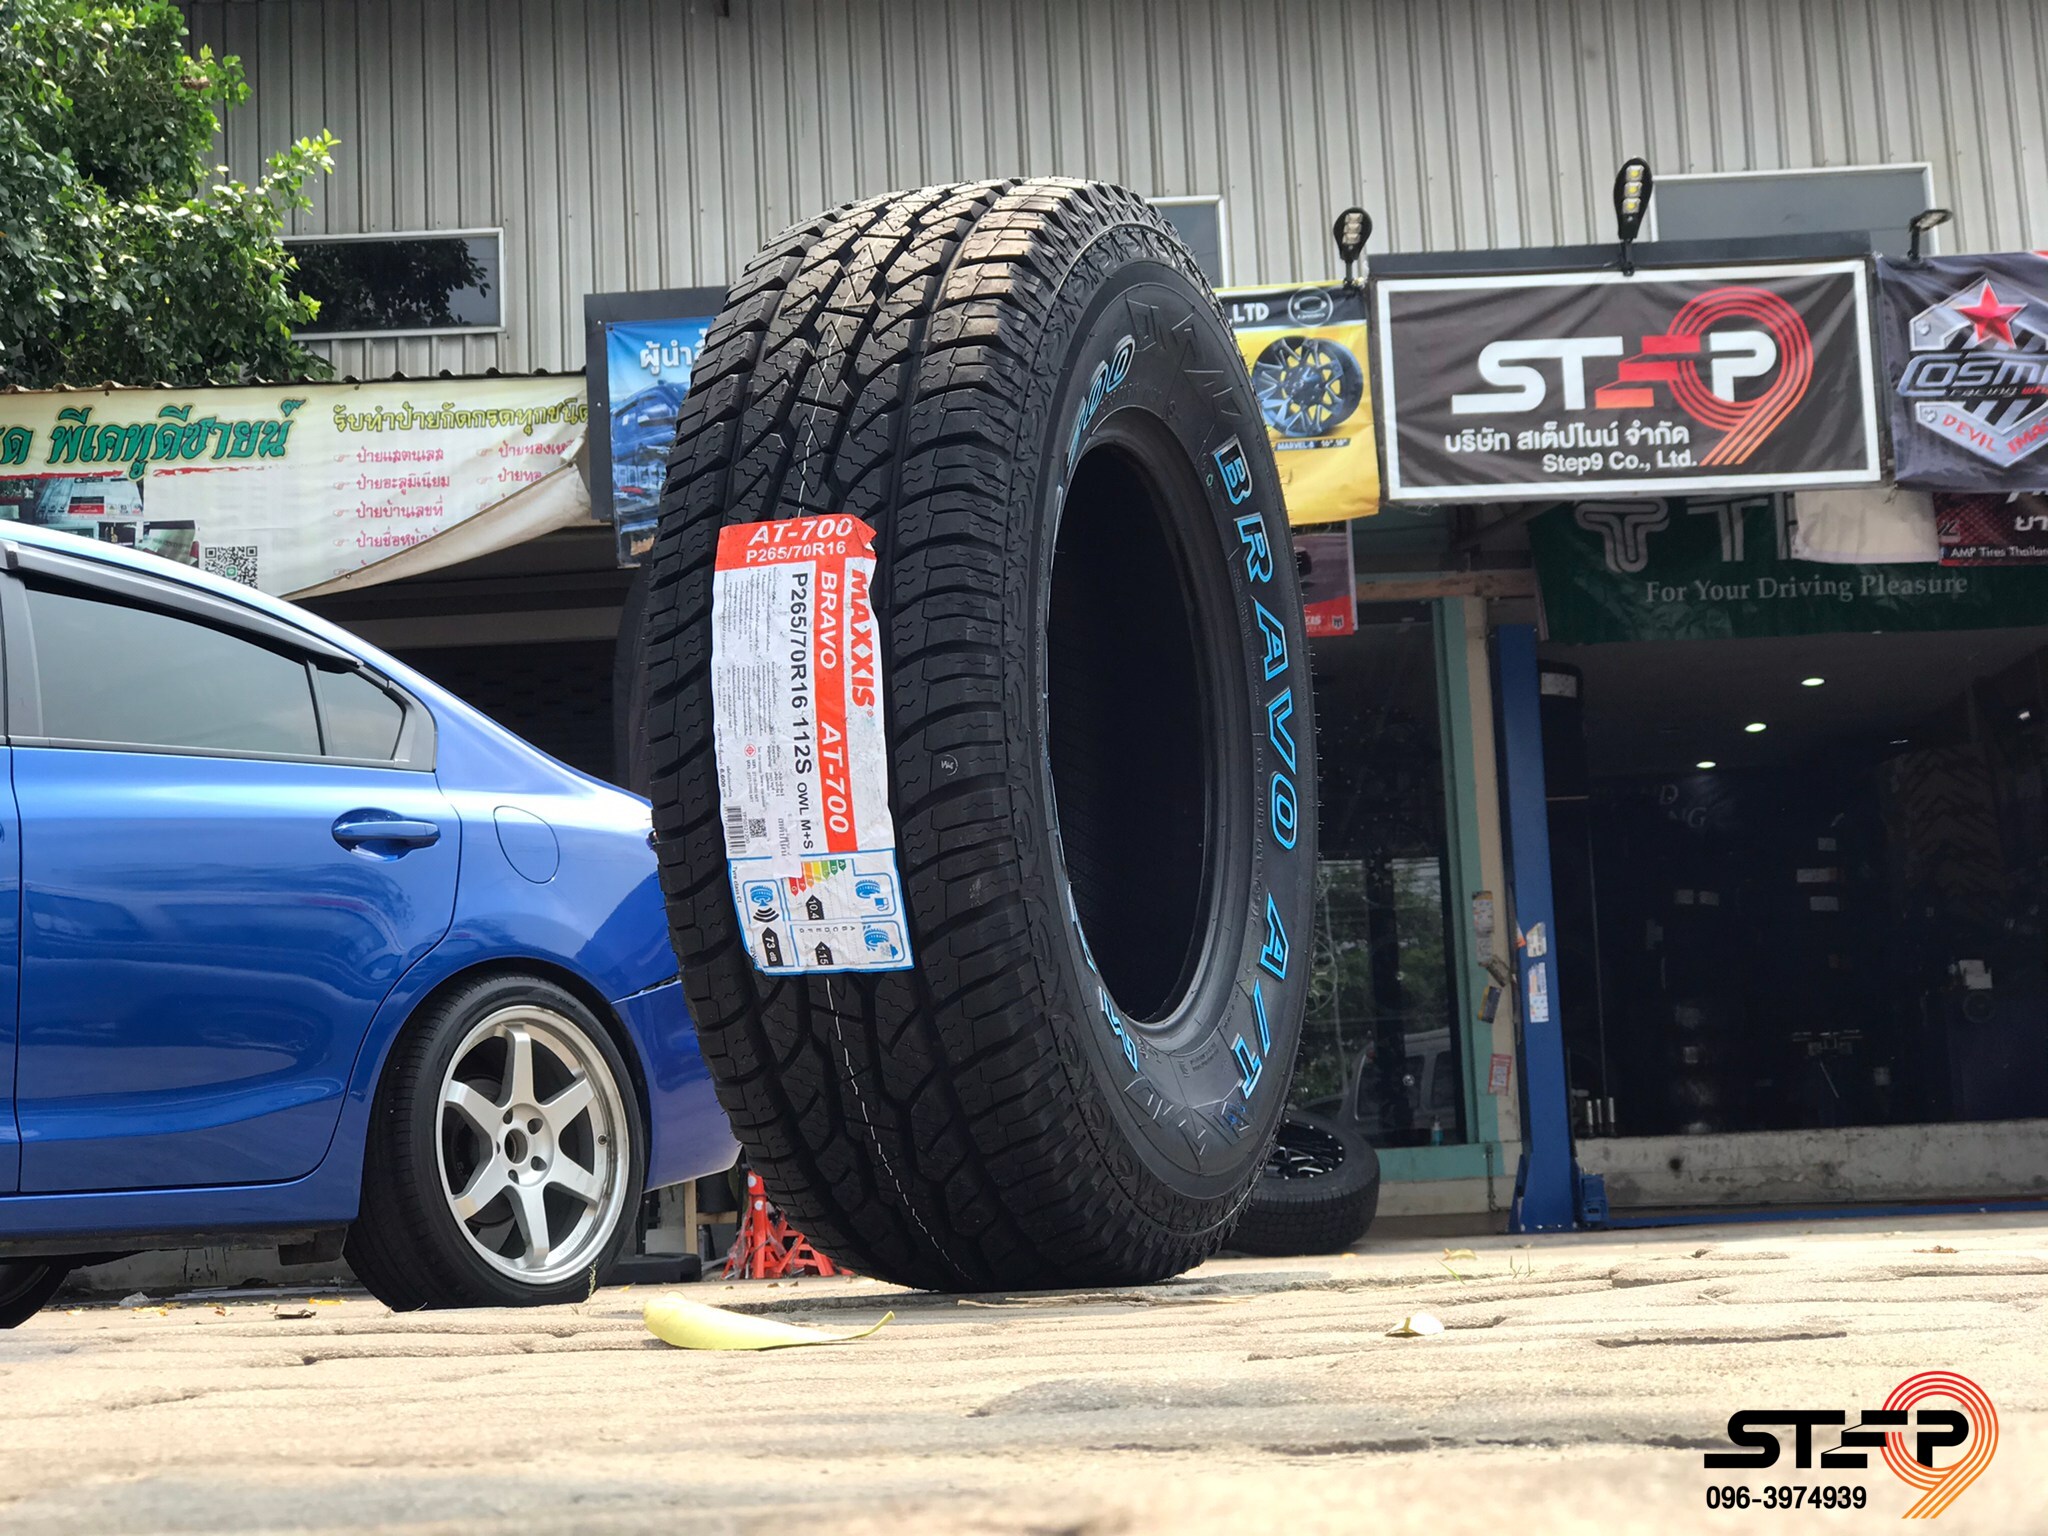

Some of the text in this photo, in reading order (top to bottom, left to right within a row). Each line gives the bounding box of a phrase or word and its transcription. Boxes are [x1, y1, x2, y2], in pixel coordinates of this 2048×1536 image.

[1445, 419, 1690, 453] บริษัท สเต็ปไนน์ จำกัด
[1943, 413, 1998, 452] DEVIL
[1542, 454, 1603, 475] Step9
[1657, 449, 1698, 468] Ltd.
[747, 518, 853, 546] AT-700
[746, 541, 846, 563] P265/70R16
[1646, 573, 1969, 603] For Your Driving Pleasure
[851, 568, 875, 709] MAXXIS
[1211, 433, 1299, 850] BRAVO
[790, 572, 813, 849] P265/70R16 112S OWL M+S
[820, 571, 849, 834] BRAVO AT-700
[808, 900, 820, 919] 10.4
[764, 936, 777, 962] 73 dB
